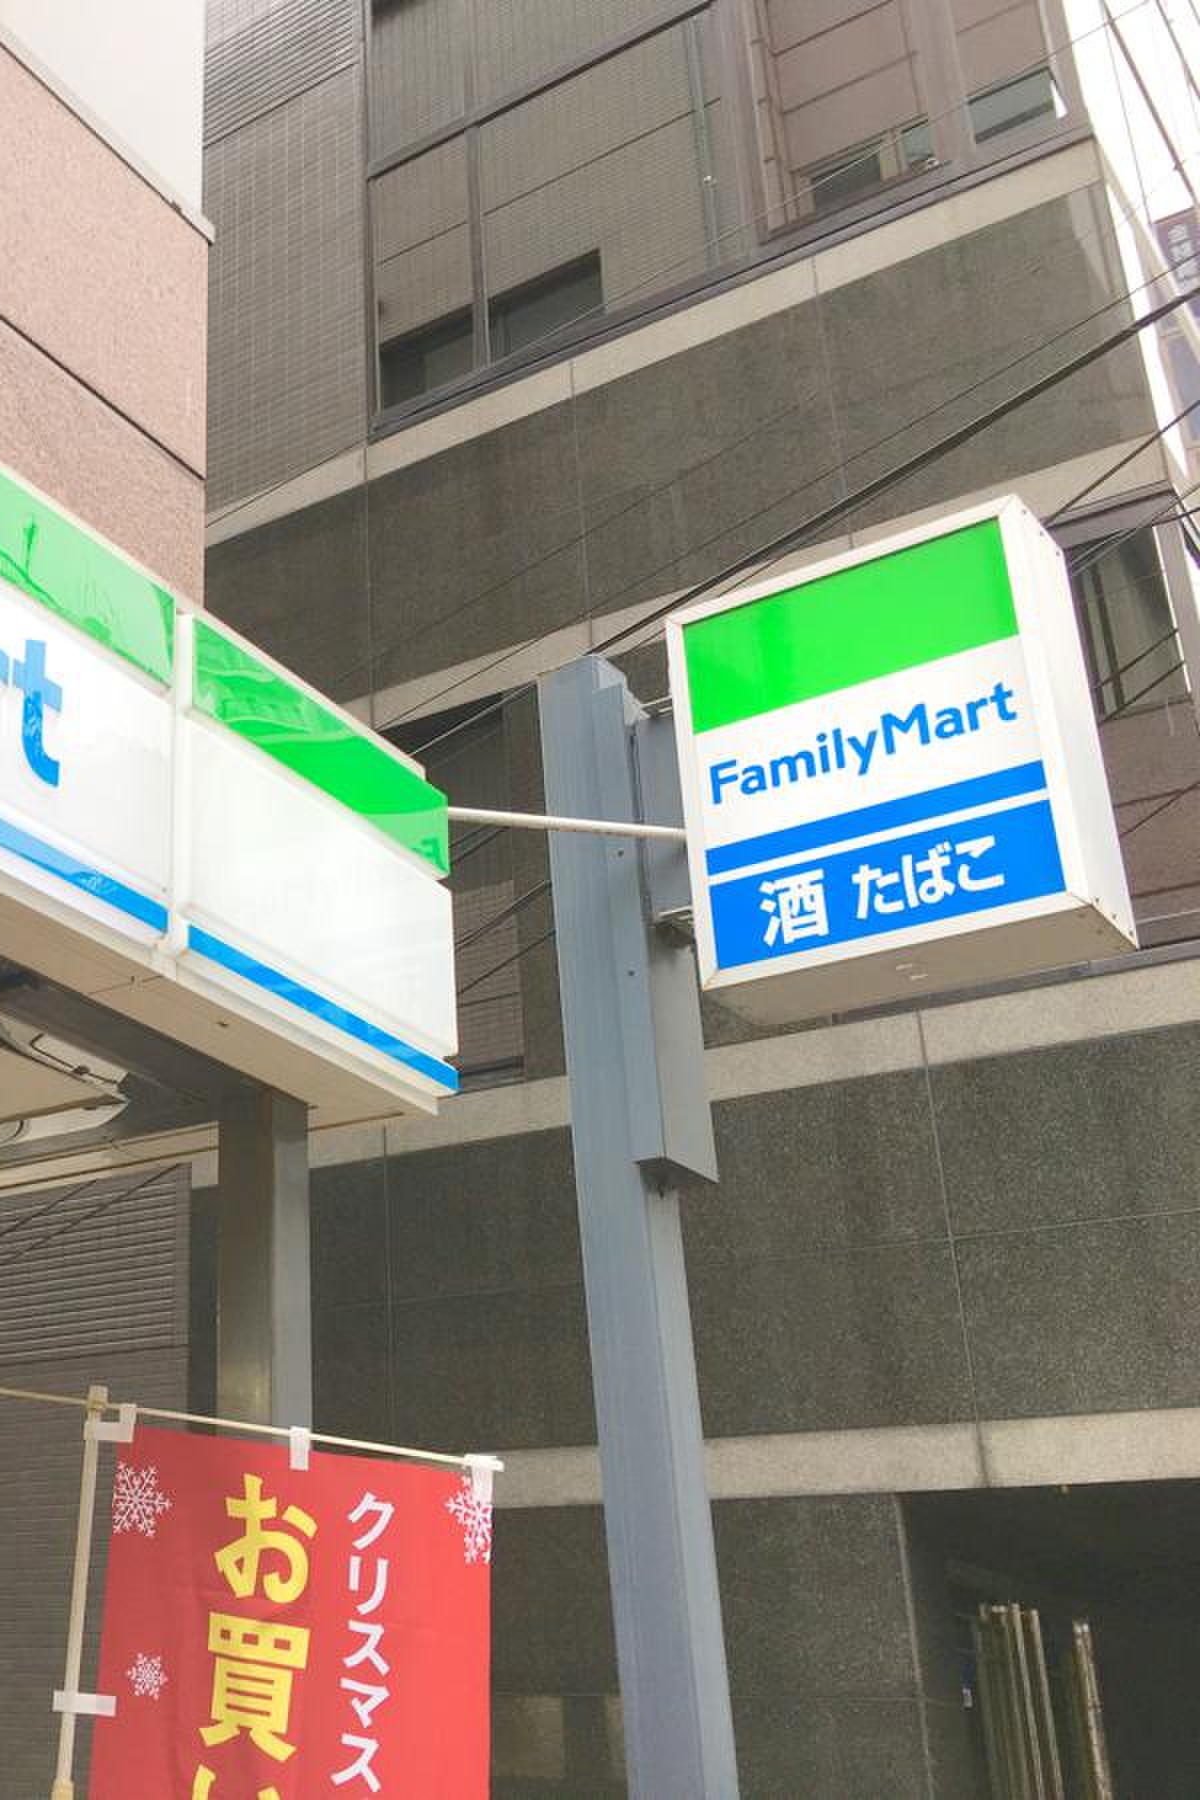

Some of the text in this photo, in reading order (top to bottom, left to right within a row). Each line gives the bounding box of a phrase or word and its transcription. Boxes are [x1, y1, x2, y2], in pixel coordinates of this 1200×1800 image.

[708, 683, 1018, 805] FamilyMart
[758, 834, 1005, 947] 酒 たばこ
[331, 1491, 396, 1794] クリスマス
